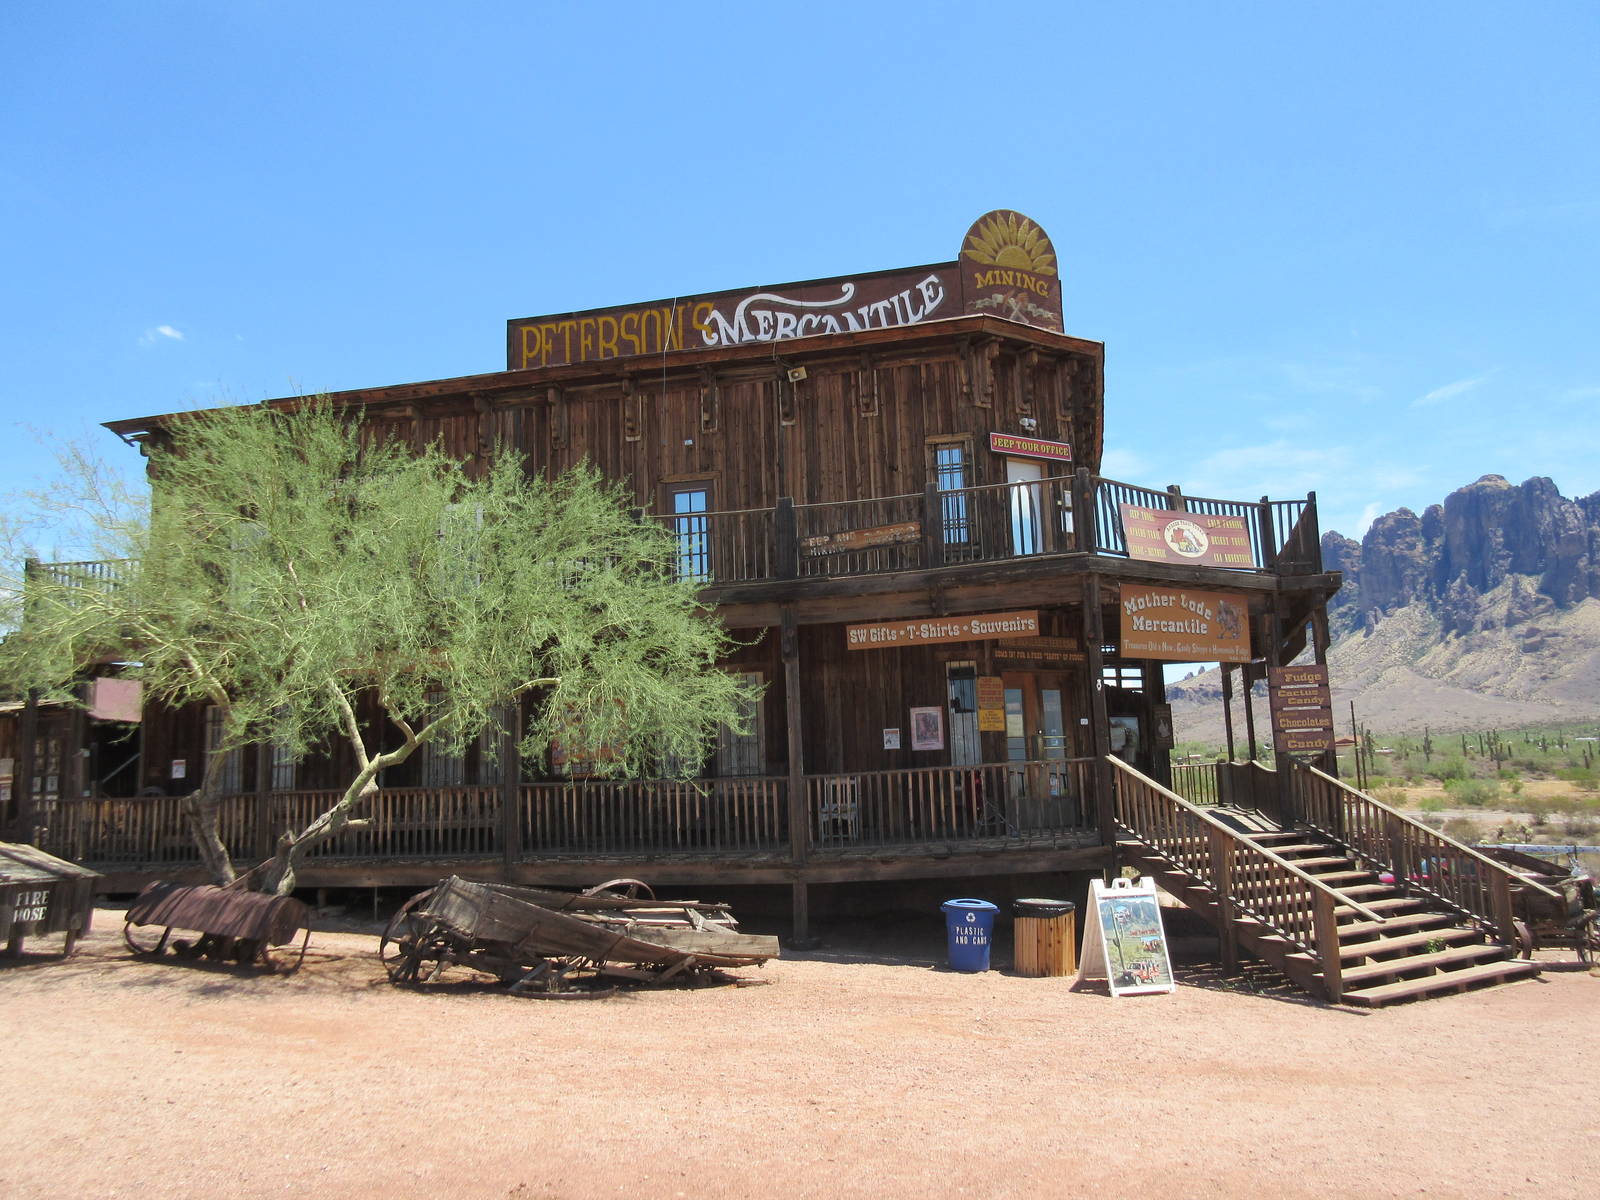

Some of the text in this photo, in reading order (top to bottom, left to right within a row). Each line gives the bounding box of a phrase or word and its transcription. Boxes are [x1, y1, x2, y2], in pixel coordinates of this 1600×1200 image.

[975, 270, 1049, 298] MINING
[992, 438, 1070, 457] JEEP TOUR OFFICE
[1124, 592, 1213, 621] Mother Lode
[850, 616, 1036, 644] SW Gifts T-Shirts Souvenirs
[1132, 616, 1208, 635] Mercantile
[1284, 672, 1322, 683] Fudge
[1288, 697, 1325, 705] Candy
[1280, 717, 1330, 728] Chocolates
[1287, 739, 1329, 750] Candy
[15, 890, 50, 907] FIRE
[13, 906, 48, 923] HOSE
[955, 926, 984, 937] PLASTIC
[955, 936, 969, 945] AND
